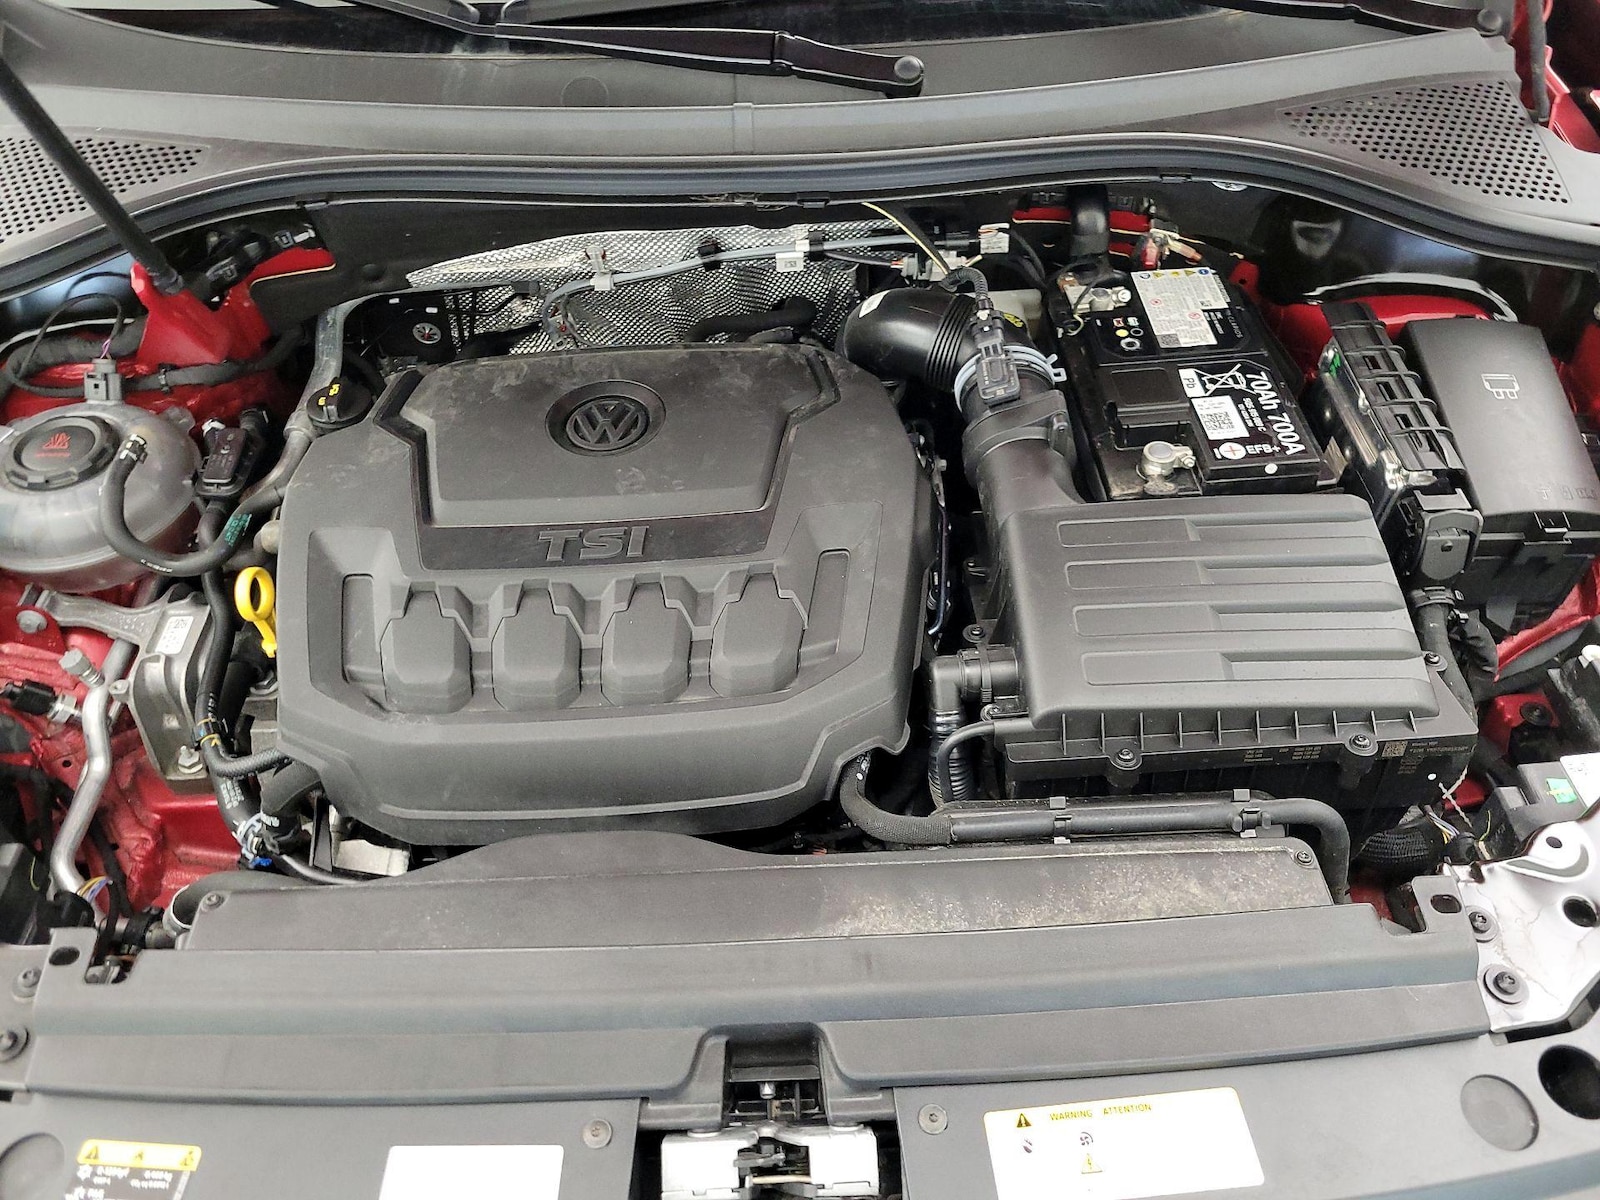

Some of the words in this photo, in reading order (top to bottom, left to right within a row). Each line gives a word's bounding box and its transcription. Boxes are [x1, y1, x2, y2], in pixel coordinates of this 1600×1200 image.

[1183, 377, 1197, 389] Pb
[566, 395, 649, 451] VW
[1246, 371, 1281, 410] 70Ah
[1267, 412, 1306, 456] 700A
[538, 525, 649, 562] TSI
[1050, 1110, 1092, 1121] WARNING
[1103, 1104, 1152, 1115] ATTENTION
